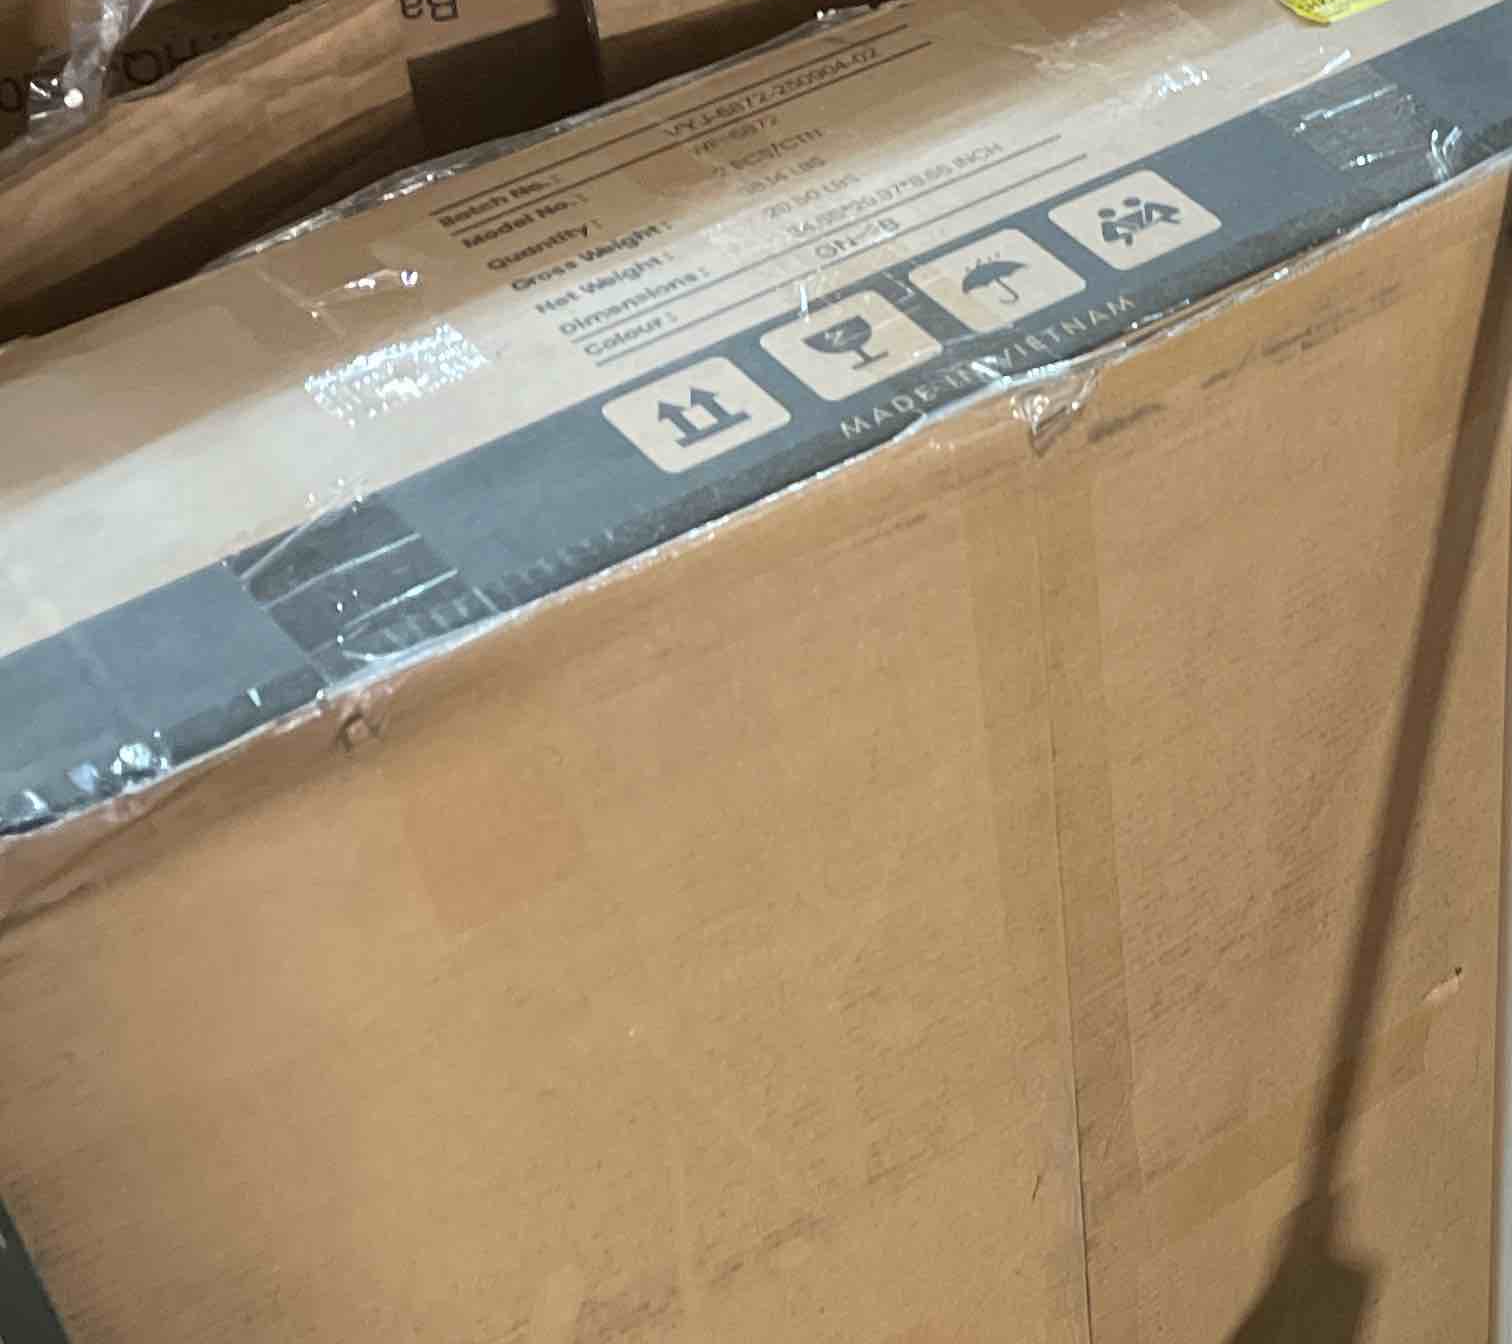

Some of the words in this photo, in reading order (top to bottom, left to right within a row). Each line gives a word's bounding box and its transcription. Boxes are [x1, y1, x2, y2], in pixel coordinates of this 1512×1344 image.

[462, 214, 535, 248] Model
[511, 259, 578, 291] Gross
[536, 290, 577, 314] Net
[840, 381, 937, 440] MADE
[997, 295, 1137, 369] VIETNAM
